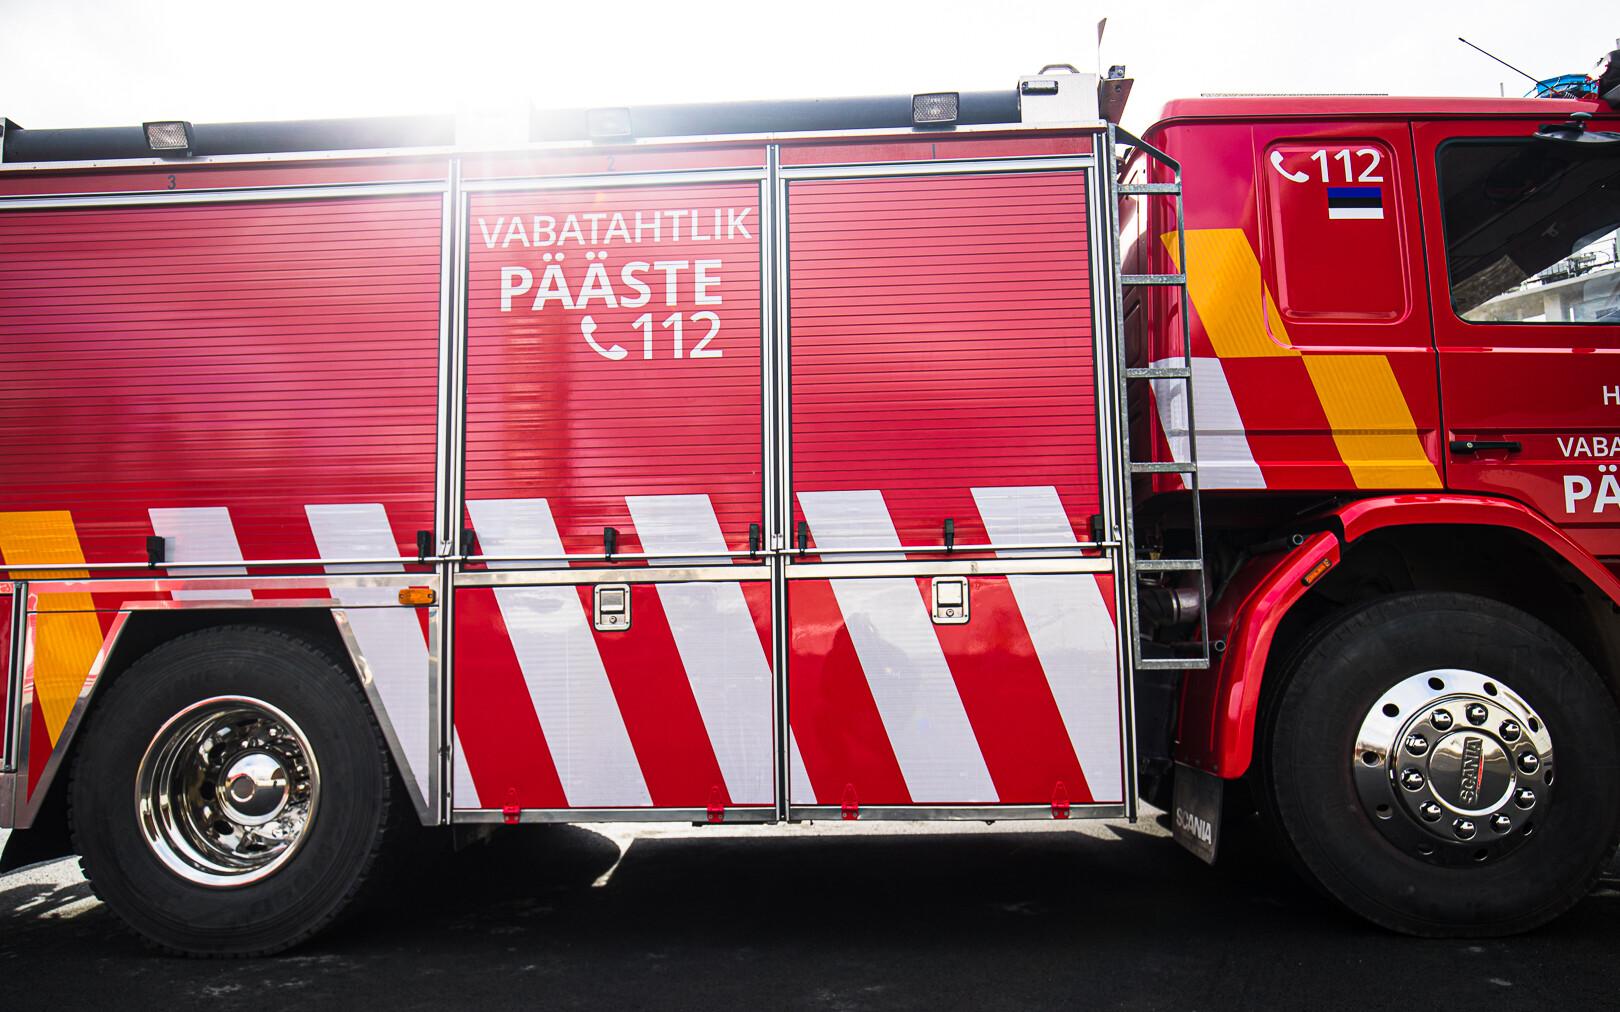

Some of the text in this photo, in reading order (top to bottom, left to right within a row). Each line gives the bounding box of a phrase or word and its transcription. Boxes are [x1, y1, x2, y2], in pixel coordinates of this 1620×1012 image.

[167, 174, 177, 190] 3
[1310, 148, 1384, 183] 112
[478, 207, 753, 249] VABATAHTLIK
[500, 250, 723, 312] PÄÄSTE
[631, 310, 724, 360] 112
[1563, 464, 1620, 513] PÄ
[1460, 738, 1481, 804] SCANIA
[1176, 807, 1212, 845] SCANIA
